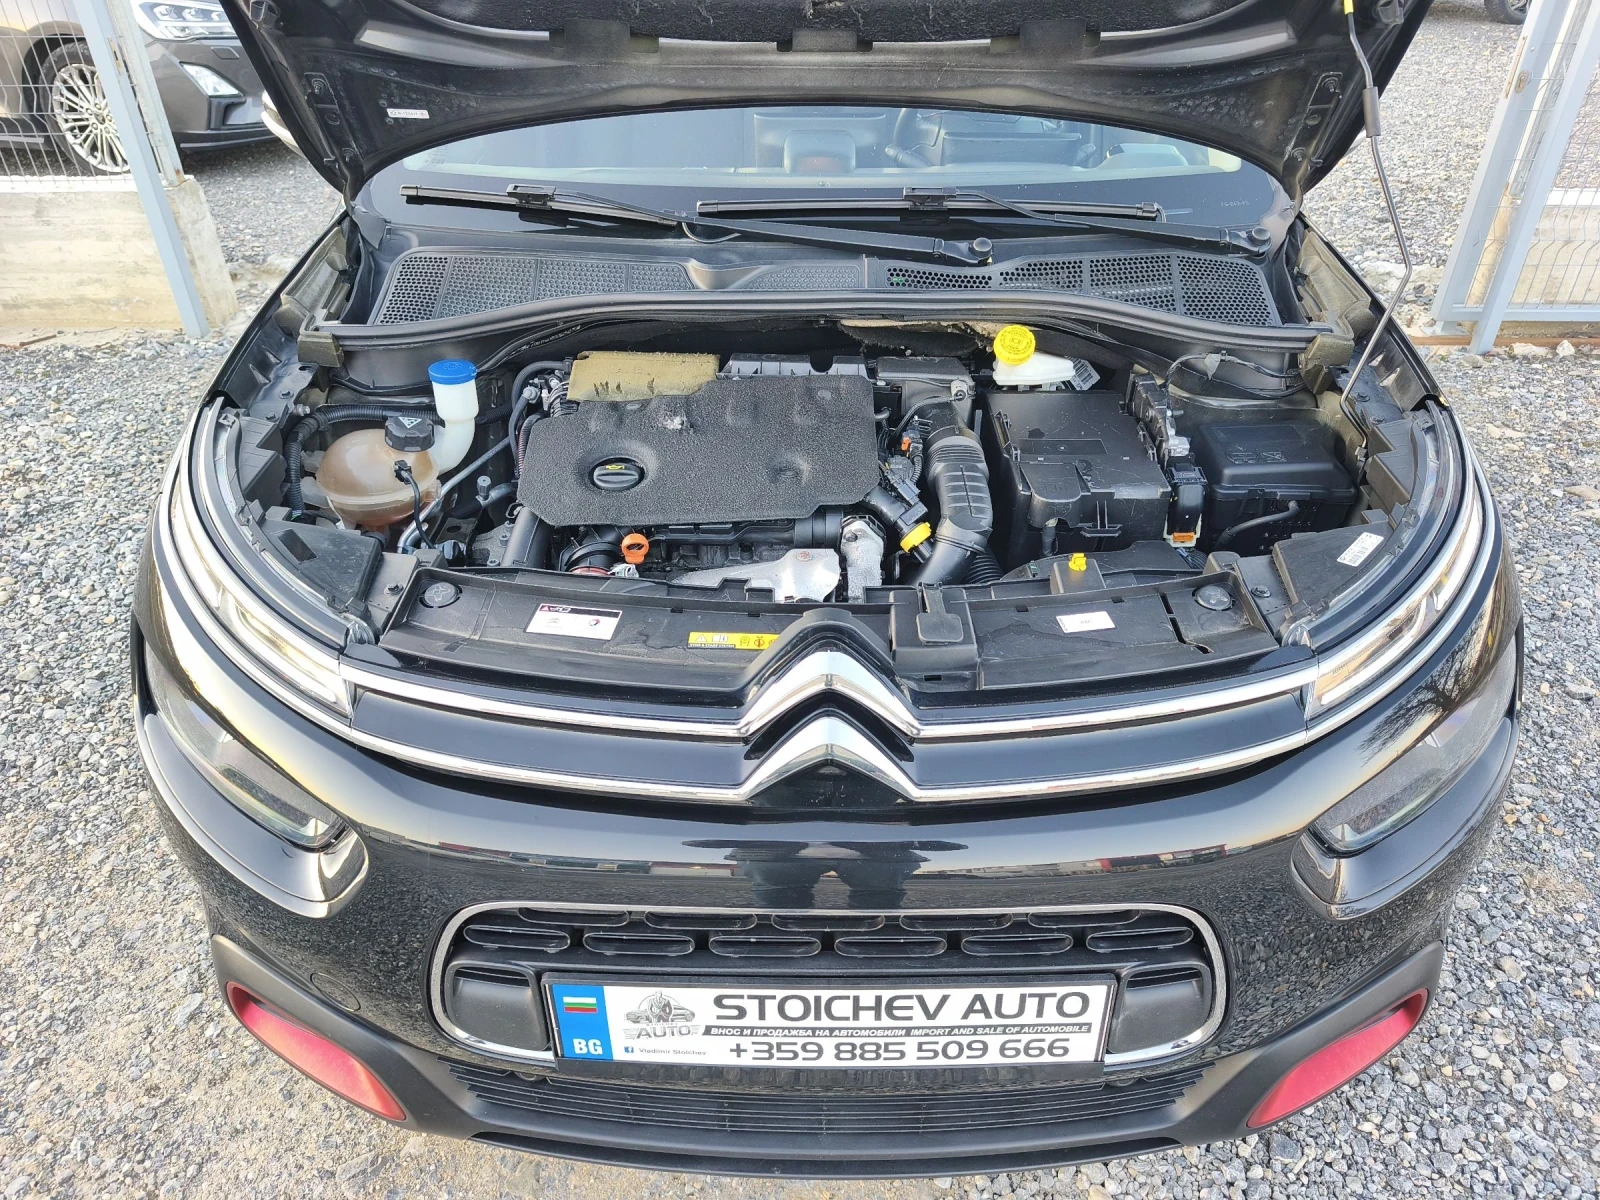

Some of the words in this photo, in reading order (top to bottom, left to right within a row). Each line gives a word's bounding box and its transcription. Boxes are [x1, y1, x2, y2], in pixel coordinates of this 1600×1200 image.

[713, 994, 951, 1022] STOICHEV
[960, 991, 1090, 1020] AUTO
[636, 1025, 691, 1039] AUTO
[710, 1027, 741, 1036] ВНОС
[742, 1028, 752, 1036] И
[753, 1028, 813, 1038] ПРОДАЖБА
[815, 1029, 831, 1037] НА
[832, 1029, 906, 1037] АВТОМОБИЛИ
[910, 1028, 951, 1036] IMPORT
[976, 1026, 1004, 1035] SALE
[1005, 1026, 1021, 1034] OF
[1021, 1025, 1089, 1034] AUTOMOBILE
[573, 1038, 603, 1055] BG
[730, 1041, 824, 1061] +359
[834, 1042, 906, 1061] 885
[916, 1040, 989, 1060] 509
[999, 1038, 1070, 1058] 666
